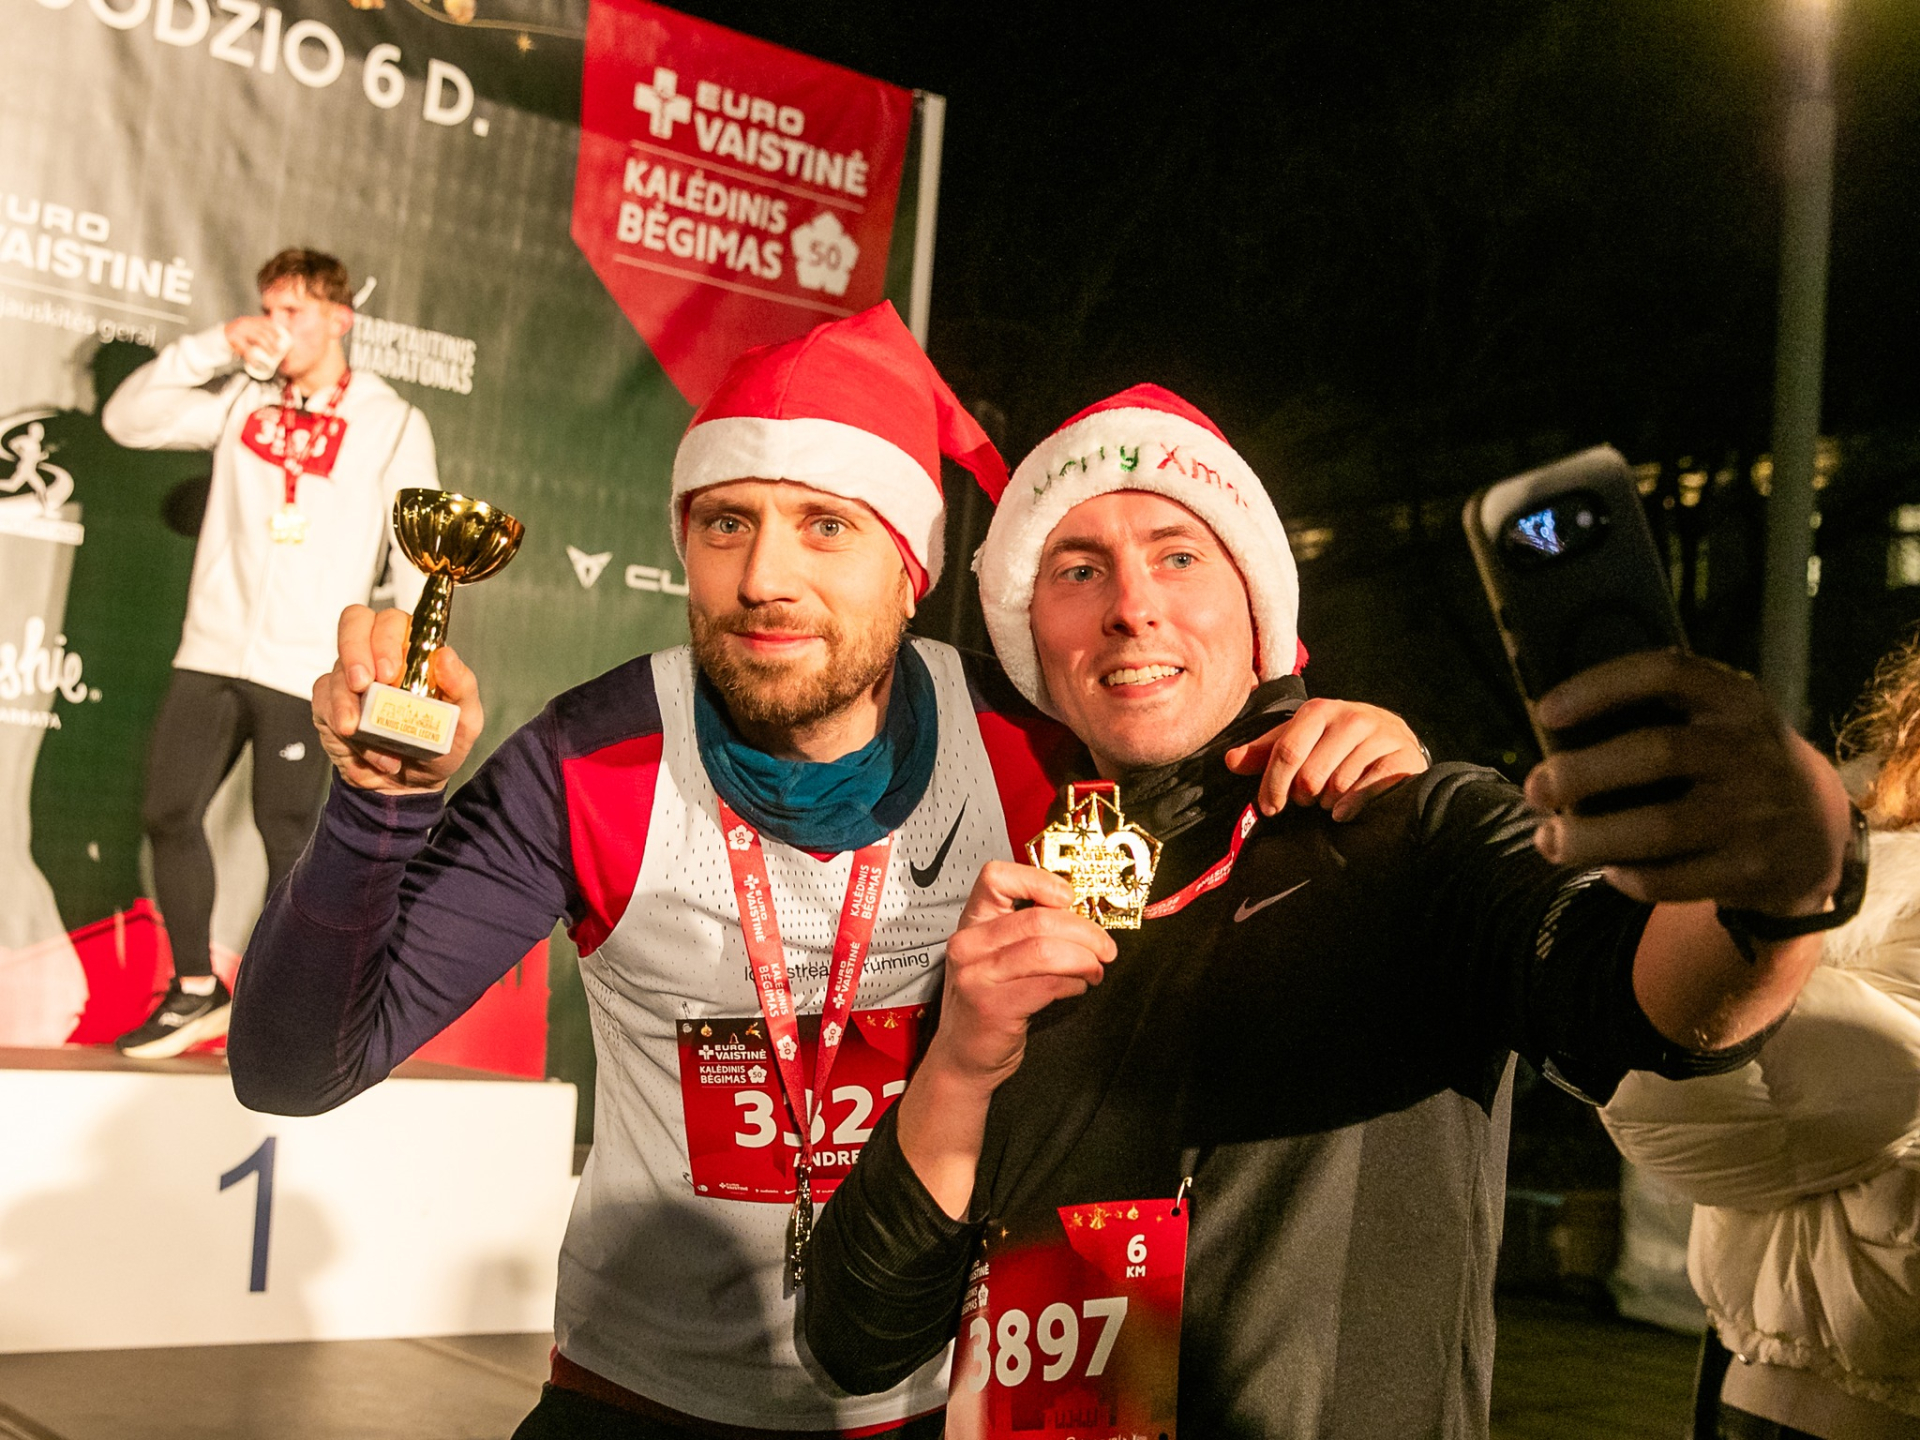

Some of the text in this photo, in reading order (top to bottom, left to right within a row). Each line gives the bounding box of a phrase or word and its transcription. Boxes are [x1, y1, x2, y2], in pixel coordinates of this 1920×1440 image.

[364, 44, 405, 109] 6
[423, 58, 490, 137] D.
[696, 80, 805, 136] EURO
[694, 111, 869, 198] VAISTINĖ
[0, 194, 110, 242] URO
[623, 158, 788, 234] KALĖDINIS
[0, 224, 194, 306] AISTINĖ
[616, 201, 843, 280] BĖGIMAS 50
[0, 297, 97, 335] auskitės
[735, 832, 746, 845] 50
[755, 889, 768, 920] EURO
[850, 864, 870, 917] KALĖDINIS
[861, 867, 882, 920] BĖGIMAS
[746, 890, 767, 944] VAISTINĖ
[758, 965, 779, 1018] BĖGIMAS
[770, 962, 789, 1016] KALĖDINIS
[834, 960, 847, 992] EURO
[841, 941, 860, 993] VAISTINĖ
[715, 1048, 767, 1060] VAISTINĖ
[782, 1042, 791, 1055] 50
[828, 1028, 837, 1041] 50
[699, 1064, 746, 1074] KALĖDINIS
[700, 1071, 762, 1084] BĖGIMAS 50
[219, 1136, 277, 1292] 1
[1126, 1234, 1148, 1264] 6
[1126, 1265, 1146, 1279] KM
[968, 1296, 1129, 1394] 3897
